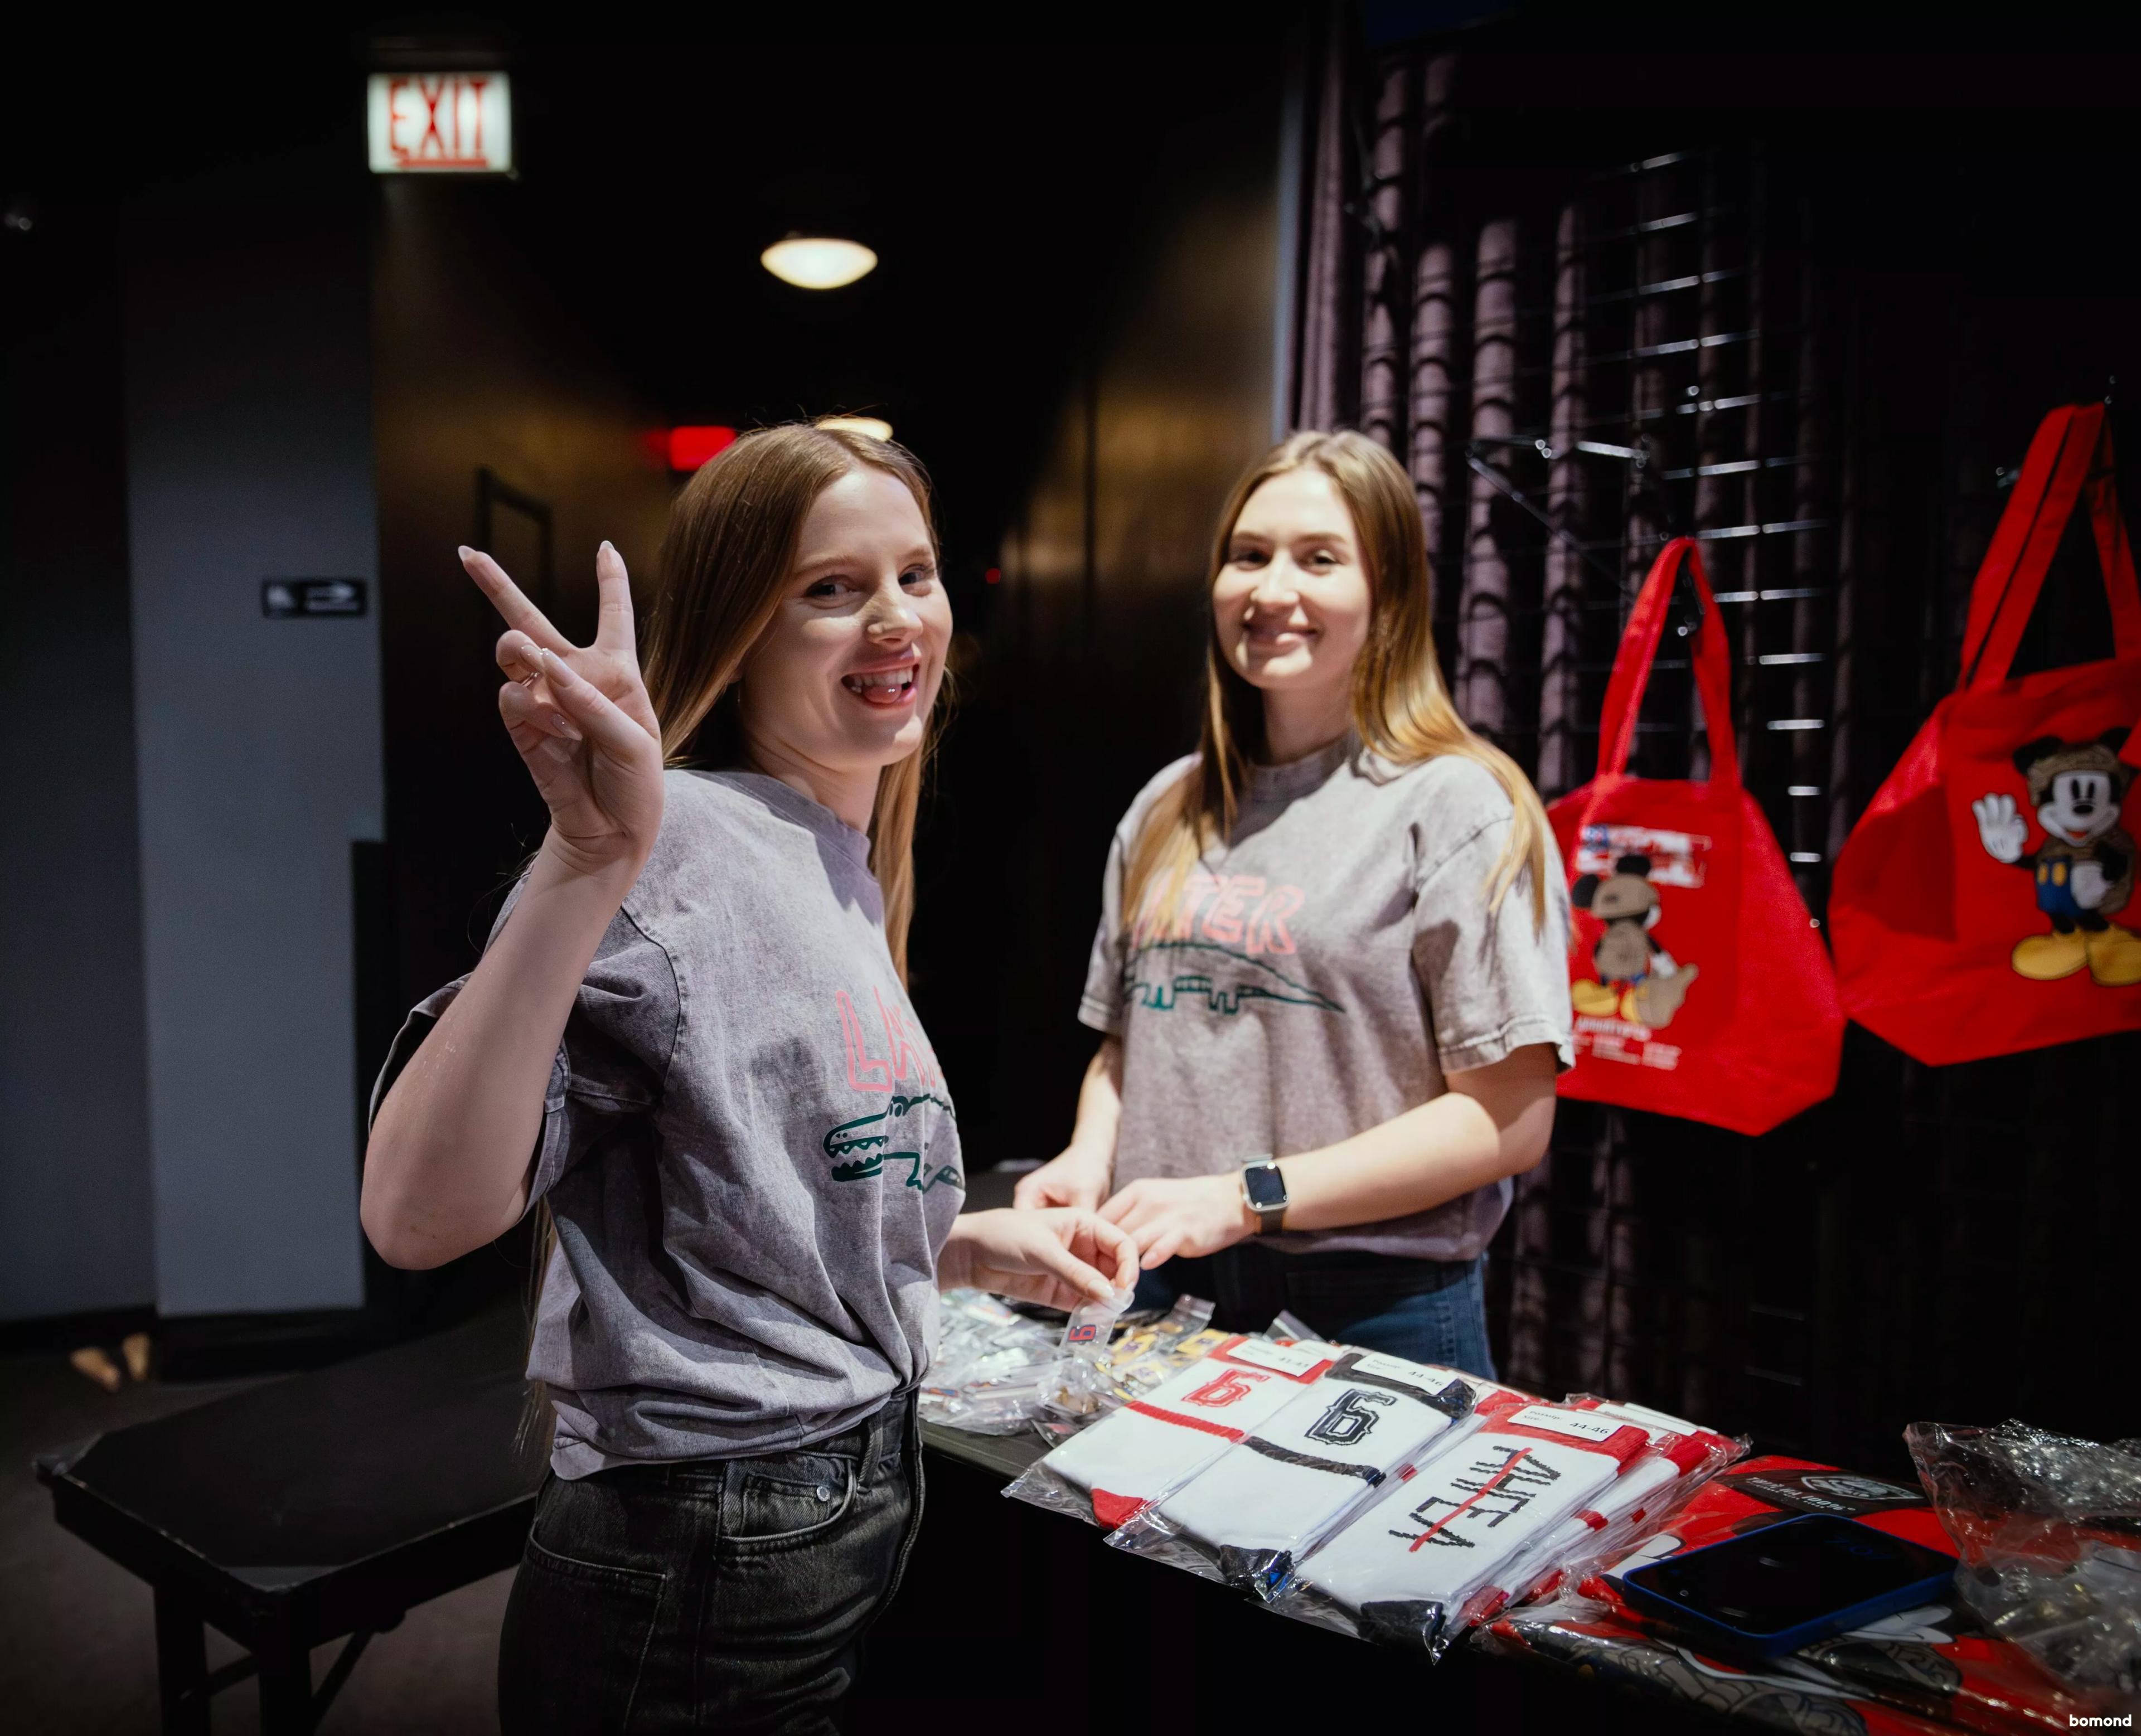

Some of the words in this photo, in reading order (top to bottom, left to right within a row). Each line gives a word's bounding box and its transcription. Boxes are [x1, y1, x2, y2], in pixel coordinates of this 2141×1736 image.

[389, 76, 487, 159] EXIT
[1132, 874, 1305, 954] TER
[1180, 1369, 1271, 1408] 6
[1408, 1371, 1444, 1386] 44-46
[1304, 1388, 1398, 1446] 6
[1570, 1423, 1610, 1434] 44-46
